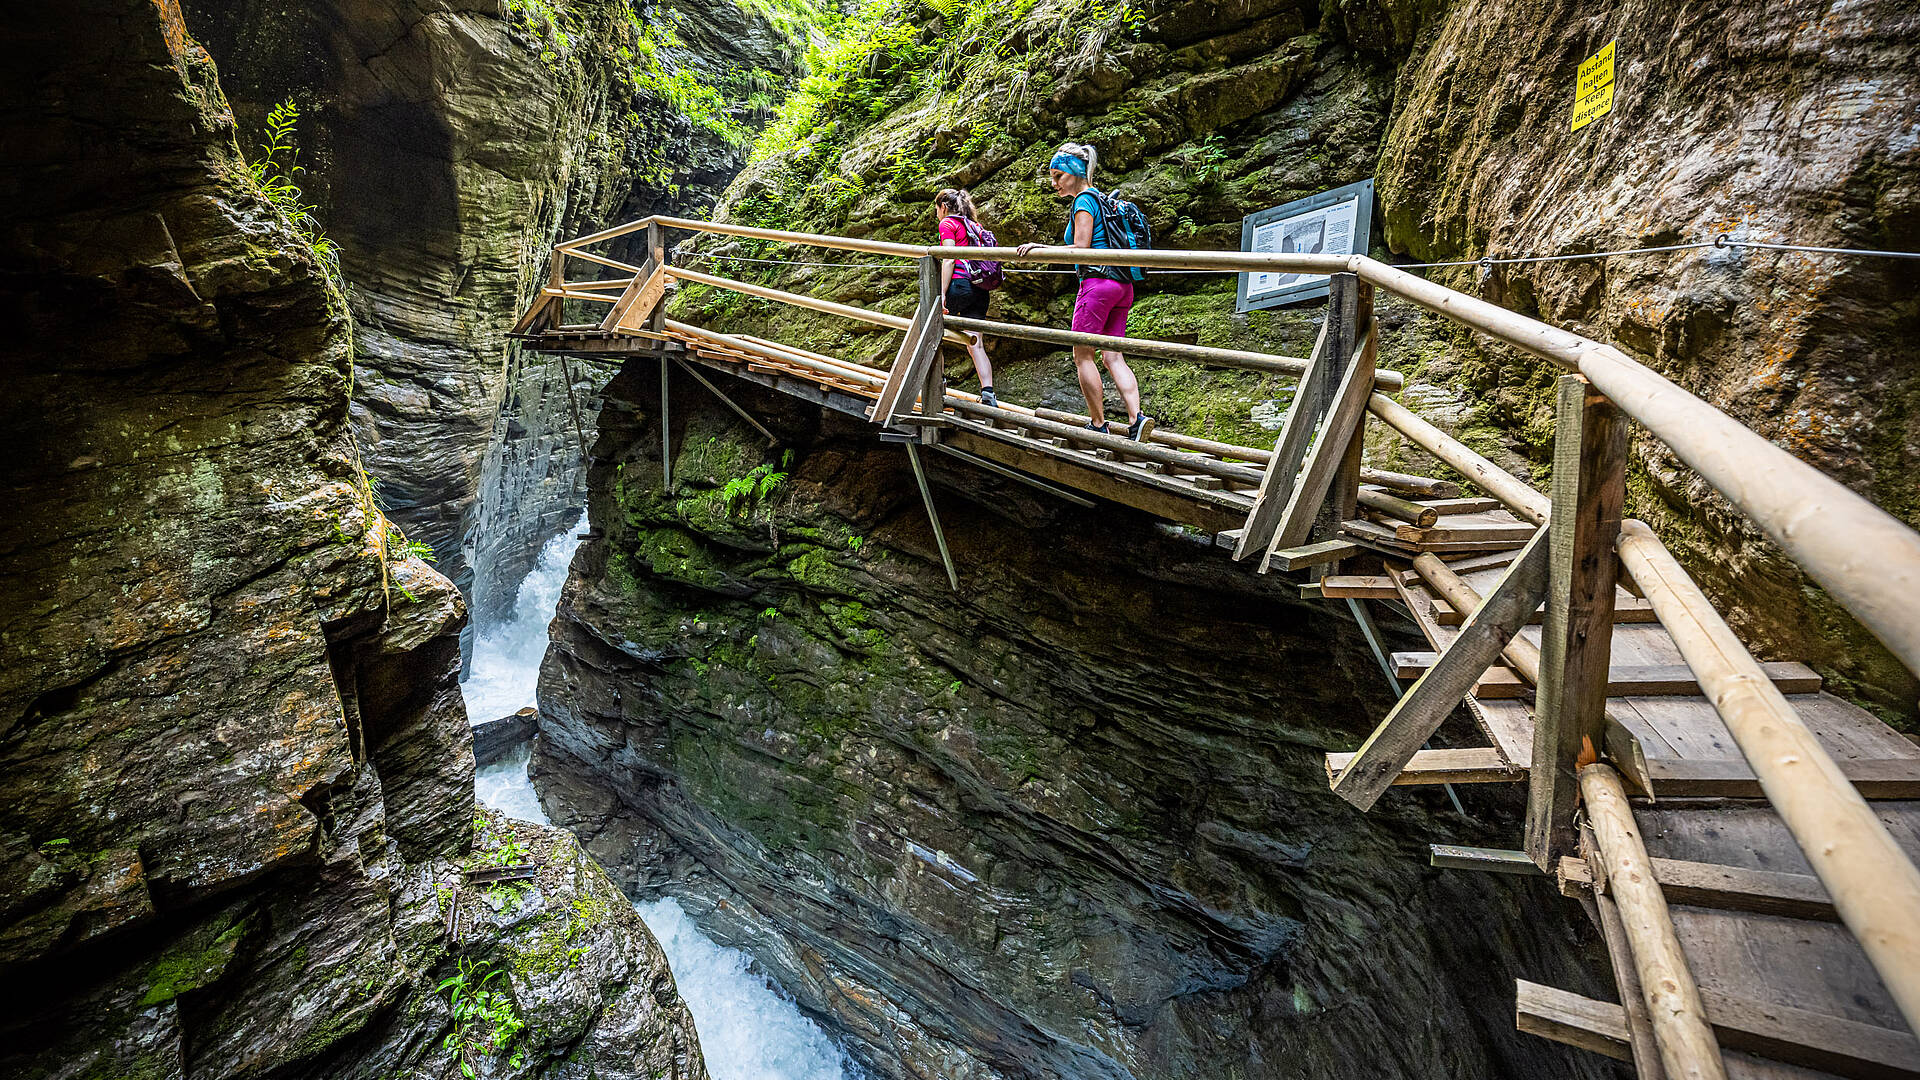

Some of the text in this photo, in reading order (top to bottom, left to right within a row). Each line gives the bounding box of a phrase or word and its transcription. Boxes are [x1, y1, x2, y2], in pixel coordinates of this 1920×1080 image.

[1580, 50, 1613, 80] Abstand
[1583, 69, 1608, 90] halten
[1585, 88, 1606, 106] Keep
[1575, 98, 1610, 122] distance
